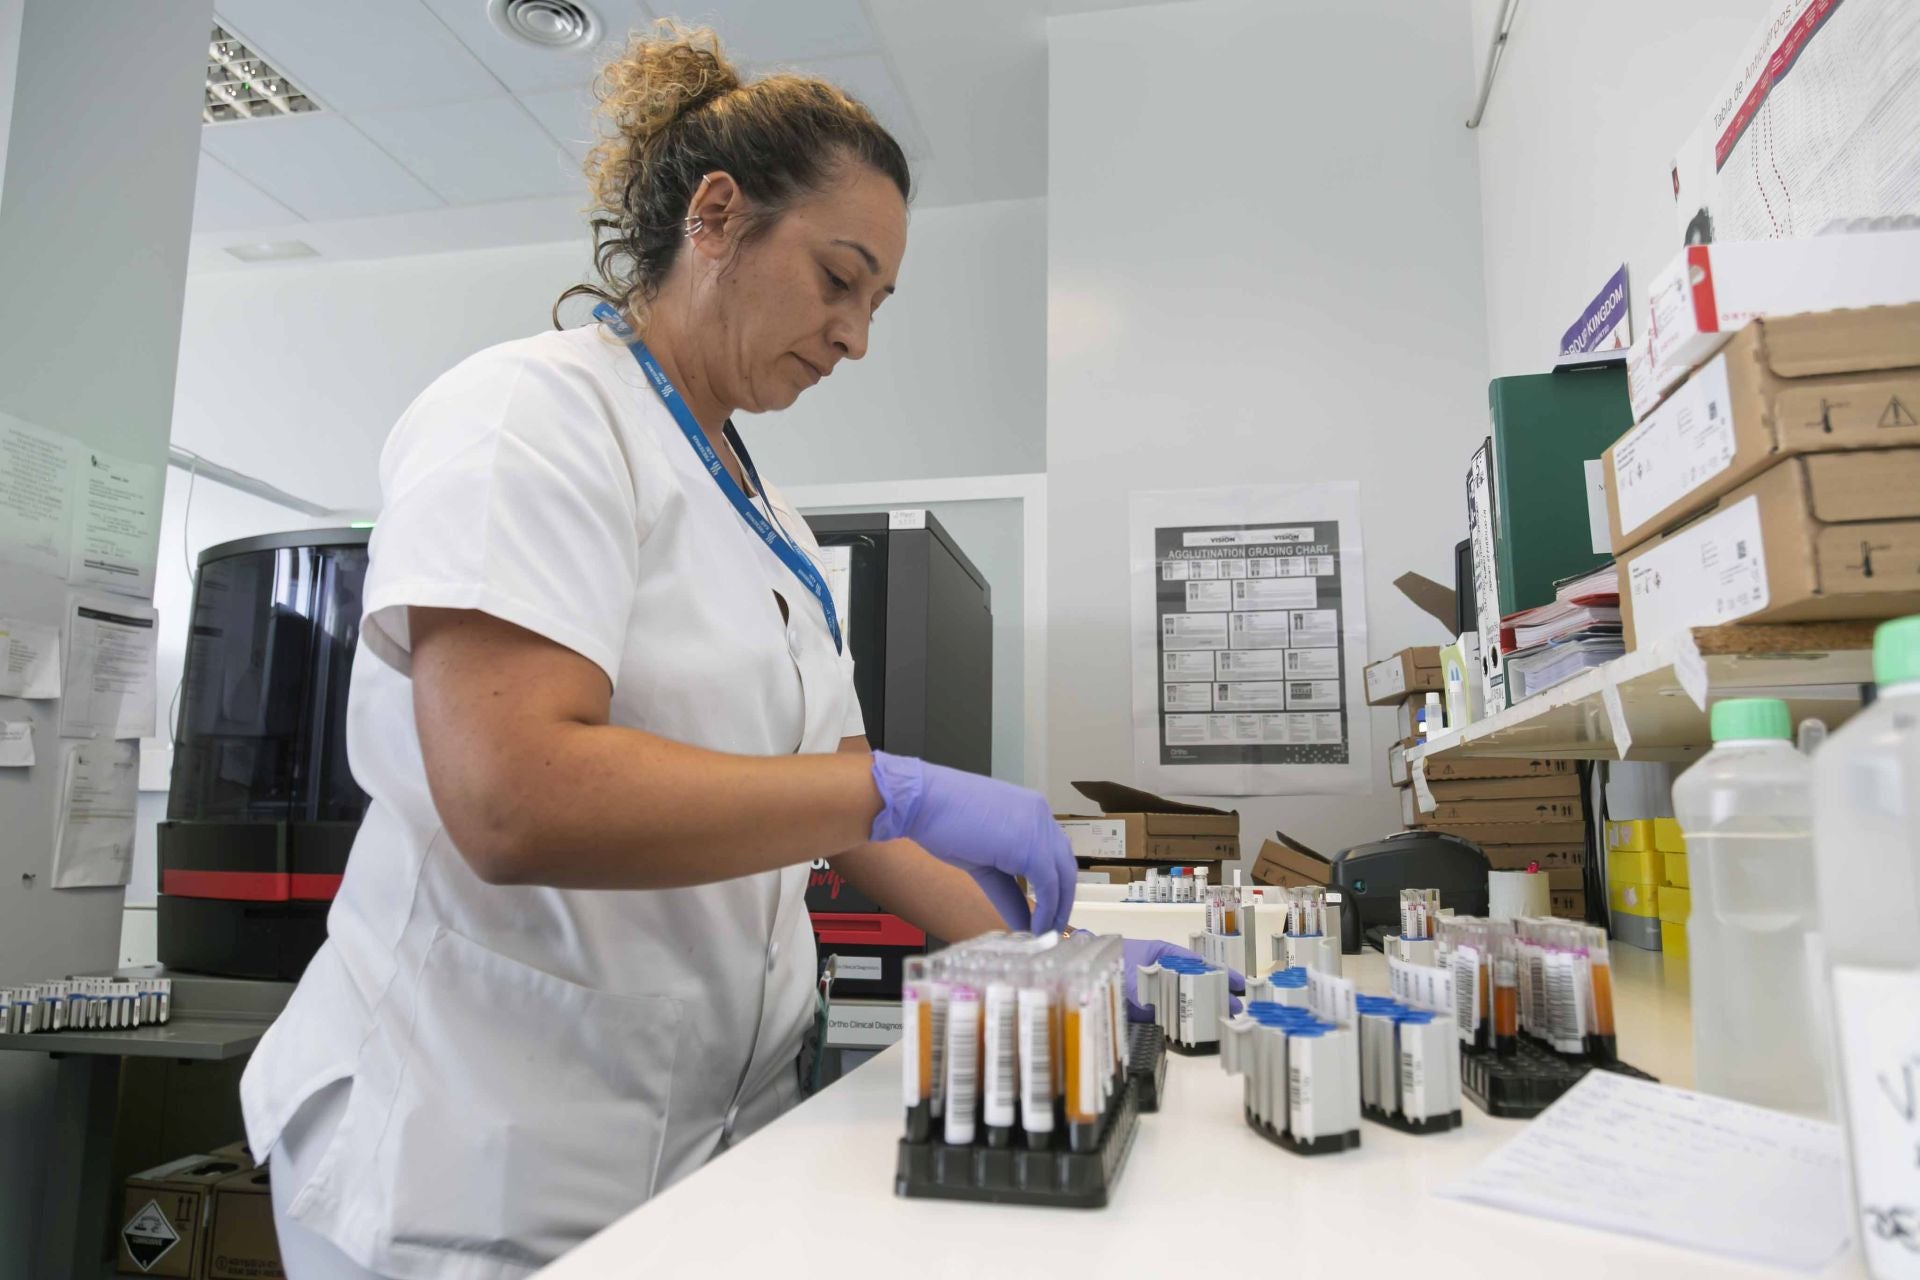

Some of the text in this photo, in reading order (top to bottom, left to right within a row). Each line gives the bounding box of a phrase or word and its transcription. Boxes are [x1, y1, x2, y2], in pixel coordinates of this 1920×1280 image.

[1713, 97, 1733, 130] Tabla
[1734, 80, 1743, 101] de
[1586, 283, 1623, 336] KINGDOM
[1168, 544, 1329, 560] AGGLUTINATION GRADING CHART
[829, 1020, 904, 1031] Ortho Clinical Diagnos
